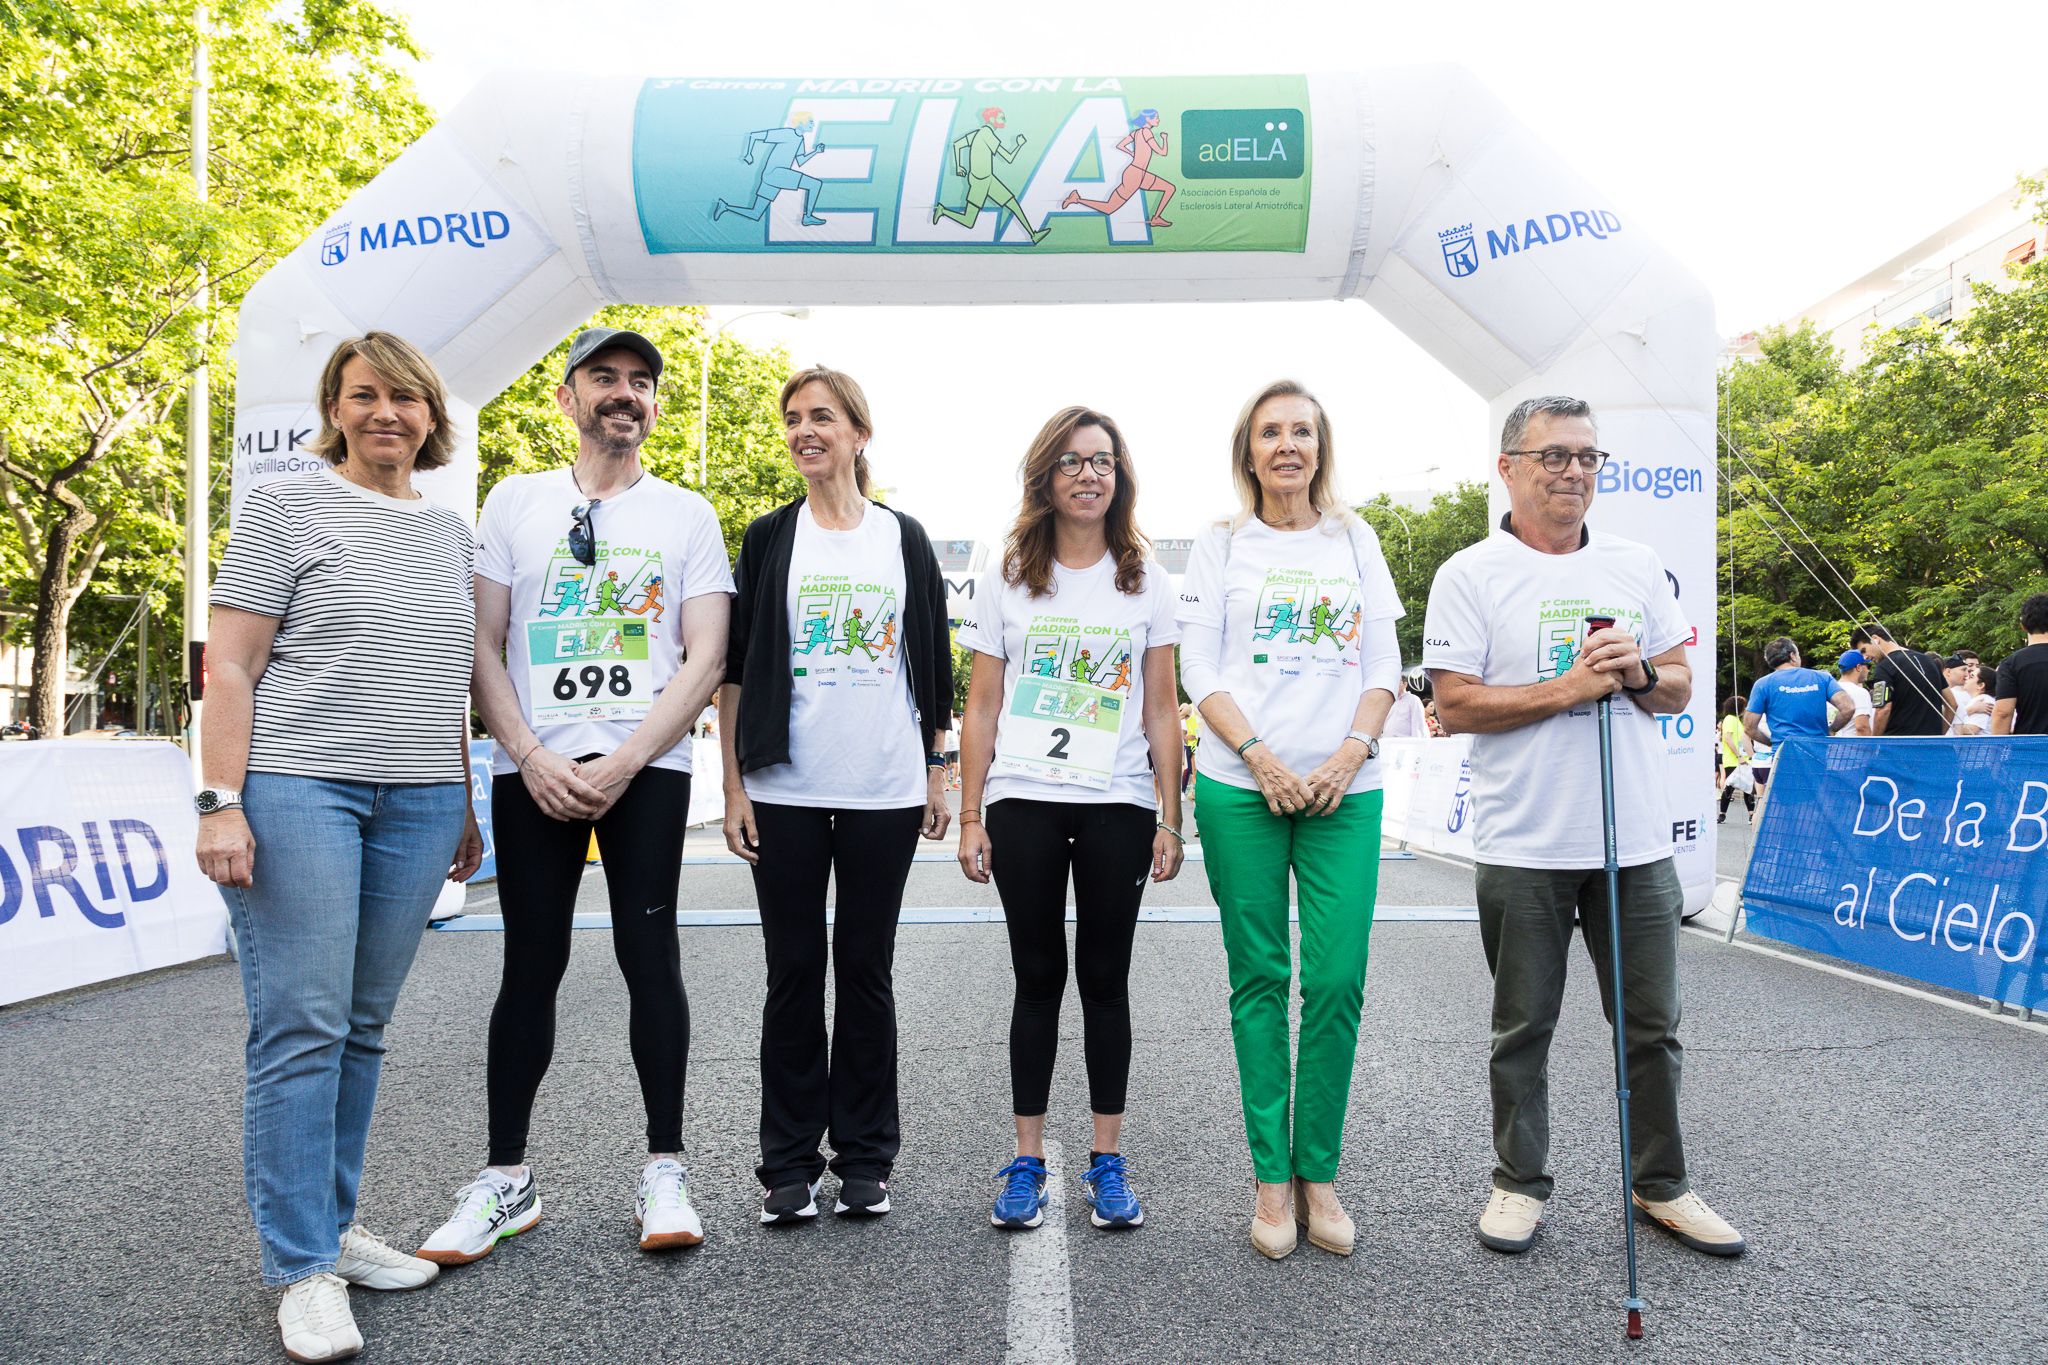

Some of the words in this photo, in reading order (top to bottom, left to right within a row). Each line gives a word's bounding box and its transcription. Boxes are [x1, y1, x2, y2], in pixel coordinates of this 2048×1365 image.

[688, 79, 787, 90] Carrera
[797, 78, 963, 93] MADRID
[974, 78, 1063, 93] CON
[1072, 77, 1123, 93] LA
[765, 96, 1154, 247] ELA
[1180, 187, 1227, 197] Asociación
[1229, 187, 1268, 198] Española
[1269, 187, 1281, 197] de
[1180, 202, 1222, 211] Esclerosis
[1224, 201, 1253, 211] Lateral
[1255, 201, 1304, 211] Amiotrófica
[360, 210, 511, 251] MADRID
[1487, 209, 1622, 260] MADRID
[1597, 461, 1704, 499] Biogen
[612, 547, 643, 557] CON
[645, 549, 662, 560] LA
[541, 556, 665, 608] ELA
[814, 574, 849, 582] Carrera
[1265, 574, 1316, 585] MADRID
[1320, 577, 1346, 586] CON
[1280, 567, 1313, 577] Carrera
[800, 583, 851, 594] MADRID
[855, 583, 881, 593] CON
[884, 586, 895, 596] LA
[1540, 607, 1595, 620] MADRID
[1598, 607, 1626, 617] CON
[1629, 611, 1642, 620] LA
[1553, 598, 1590, 607] Carrera
[557, 621, 588, 630] MADRID
[589, 620, 606, 628] CON
[794, 594, 897, 644] ELA
[1028, 624, 1081, 633] MADRID
[1083, 625, 1112, 635] CON
[1114, 627, 1130, 637] LA
[1045, 615, 1079, 624] Carrera
[554, 628, 622, 659] ELA
[1022, 633, 1132, 685] ELA
[553, 665, 632, 700] 698
[1031, 688, 1097, 724] ELA
[1047, 728, 1071, 760] 2
[1853, 775, 1926, 842] De
[1943, 779, 1987, 849] la
[2006, 780, 2048, 853] B
[1834, 866, 1877, 930] al
[1889, 872, 2036, 963] Cielo
